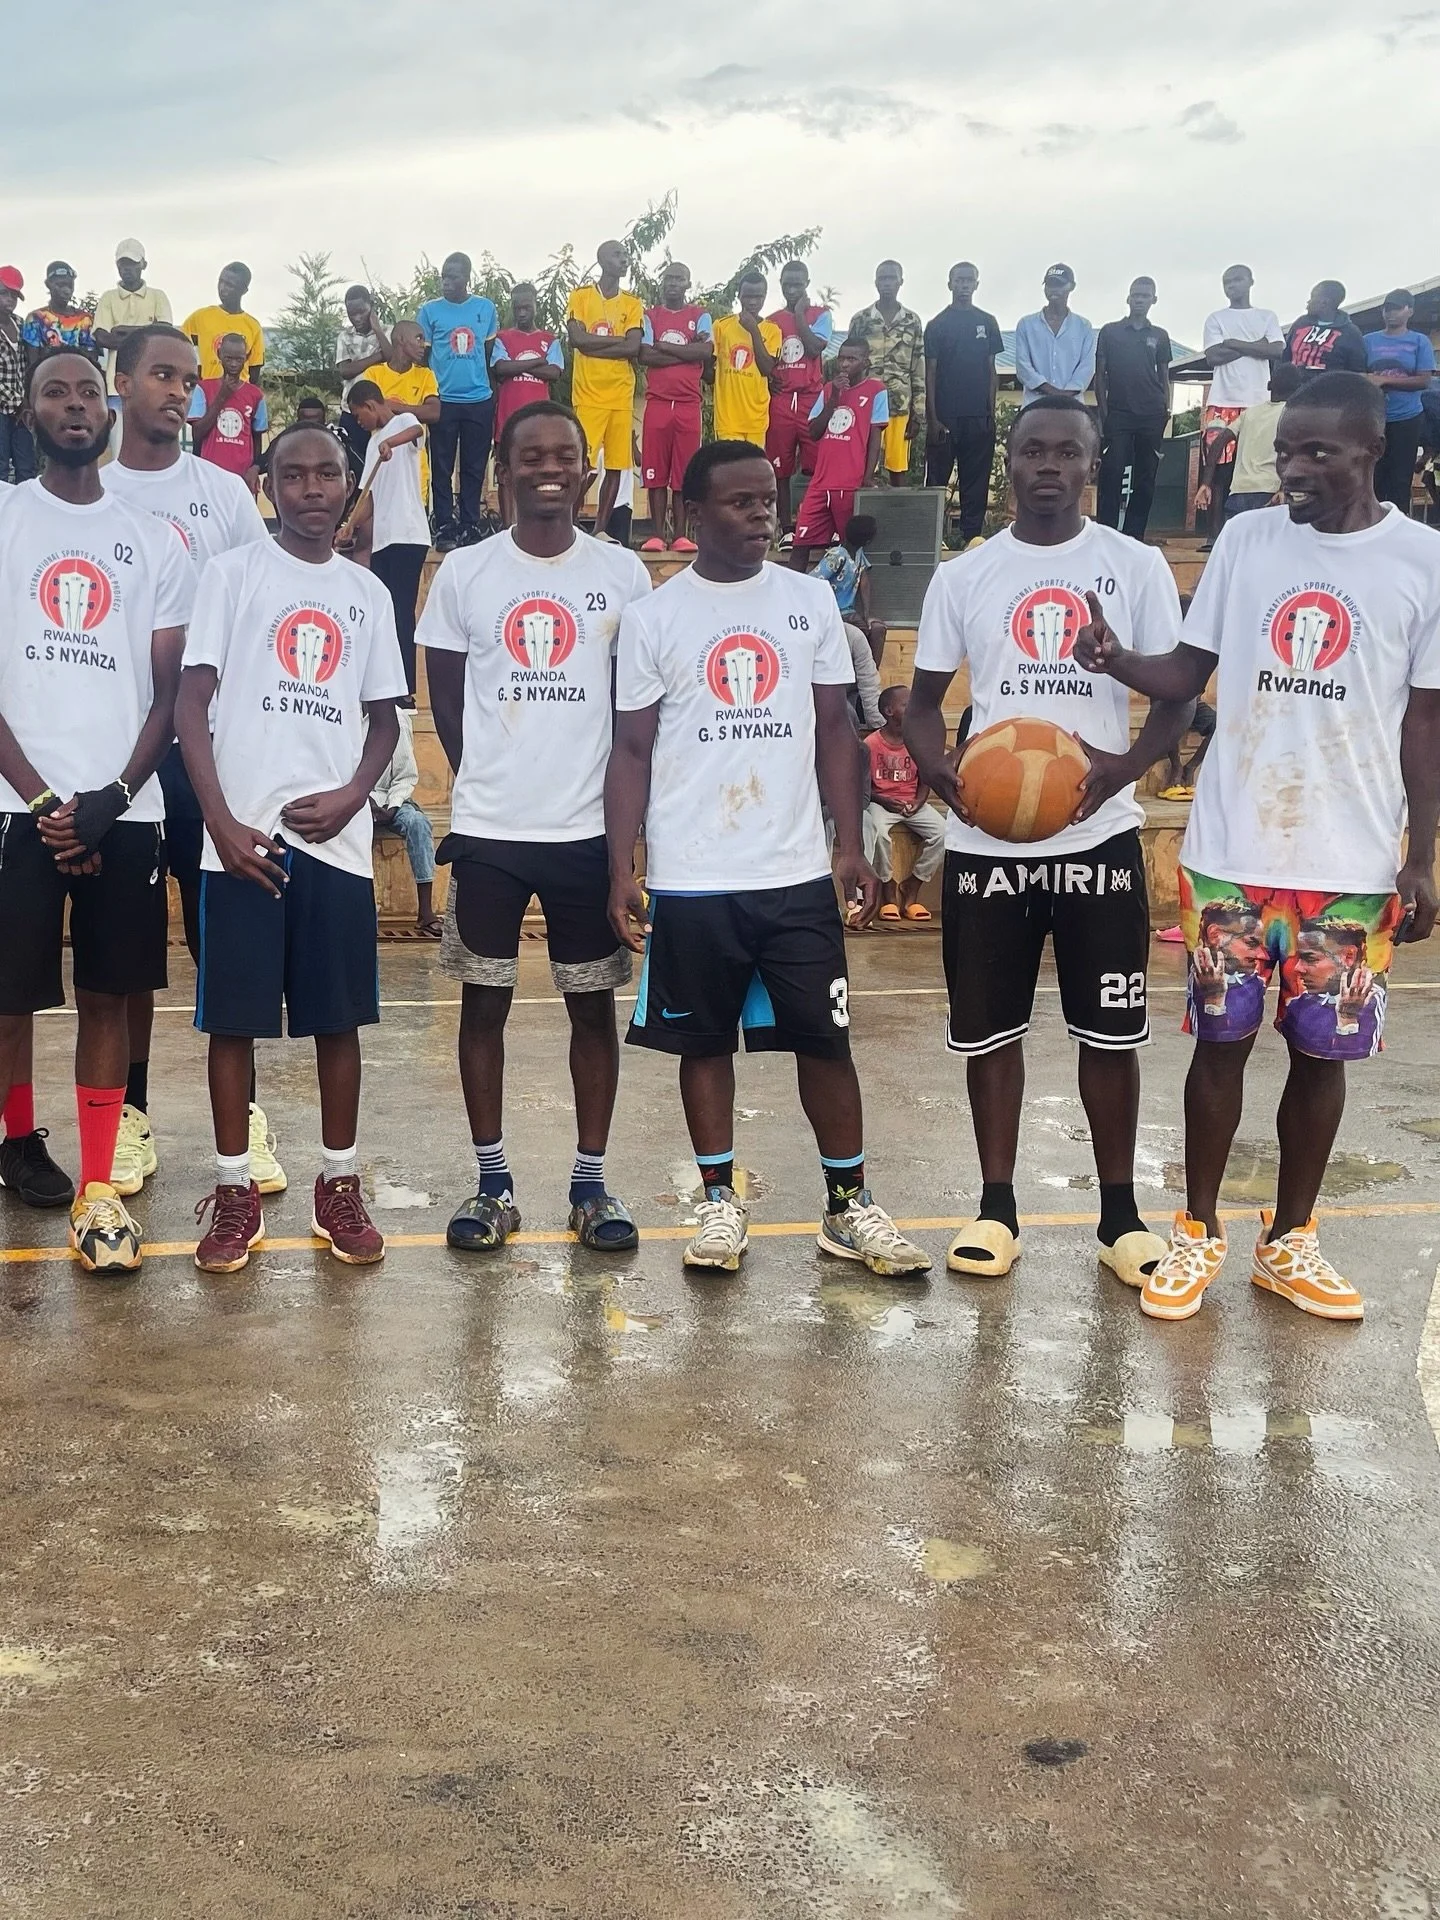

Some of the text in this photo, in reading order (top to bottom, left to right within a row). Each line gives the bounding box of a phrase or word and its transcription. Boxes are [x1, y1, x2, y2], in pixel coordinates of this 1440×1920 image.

[688, 321, 696, 331] 6
[412, 386, 420, 396] 7
[859, 395, 869, 407] 7
[244, 405, 253, 418] 2
[773, 456, 781, 468] 4
[646, 468, 655, 480] 6
[190, 502, 209, 518] 06
[799, 526, 809, 538] 7
[114, 542, 133, 565] 02
[30, 549, 122, 613] INTERNATIONAL SPORTS & MUSIC PROJECT
[1095, 576, 1116, 595] 10
[300, 600, 325, 611] SPORTS
[585, 592, 607, 611] 29
[1003, 586, 1033, 637] INTERNATIONAL
[1034, 579, 1065, 589] SPORTS
[1066, 581, 1072, 589] &
[332, 612, 349, 634] MUSIC
[349, 605, 365, 628] 07
[494, 596, 521, 646] INTERNATIONAL
[522, 590, 549, 600] SPORTS
[558, 595, 578, 614] MUSIC
[575, 614, 585, 644] PROJECT
[788, 614, 810, 631] 08
[1261, 581, 1362, 655] INTERNATIONAL SPORTS & MUSIC PROJECT
[267, 602, 298, 651] INTERNATIONAL
[43, 629, 99, 647] RWANDA
[25, 645, 117, 672] G. S NYANZA
[340, 635, 352, 668] PROJECT
[697, 634, 723, 686] INTERNATIONAL
[722, 625, 751, 636] SPORTS
[760, 629, 779, 648] MUSIC
[779, 648, 789, 679] PROJECT
[511, 671, 566, 682] RWANDA
[1018, 663, 1077, 674] RWANDA
[278, 680, 329, 700] RWANDA
[498, 686, 586, 702] G. S NYANZA
[1000, 679, 1093, 698] G. S NYANZA
[1257, 670, 1347, 701] Rwanda
[262, 696, 342, 725] G. S NYANZA
[715, 707, 772, 721] RWANDA
[698, 723, 792, 742] G. S NYANZA
[982, 863, 1107, 898] AMIRI
[1100, 971, 1145, 1009] 22
[829, 976, 850, 1028] 3
